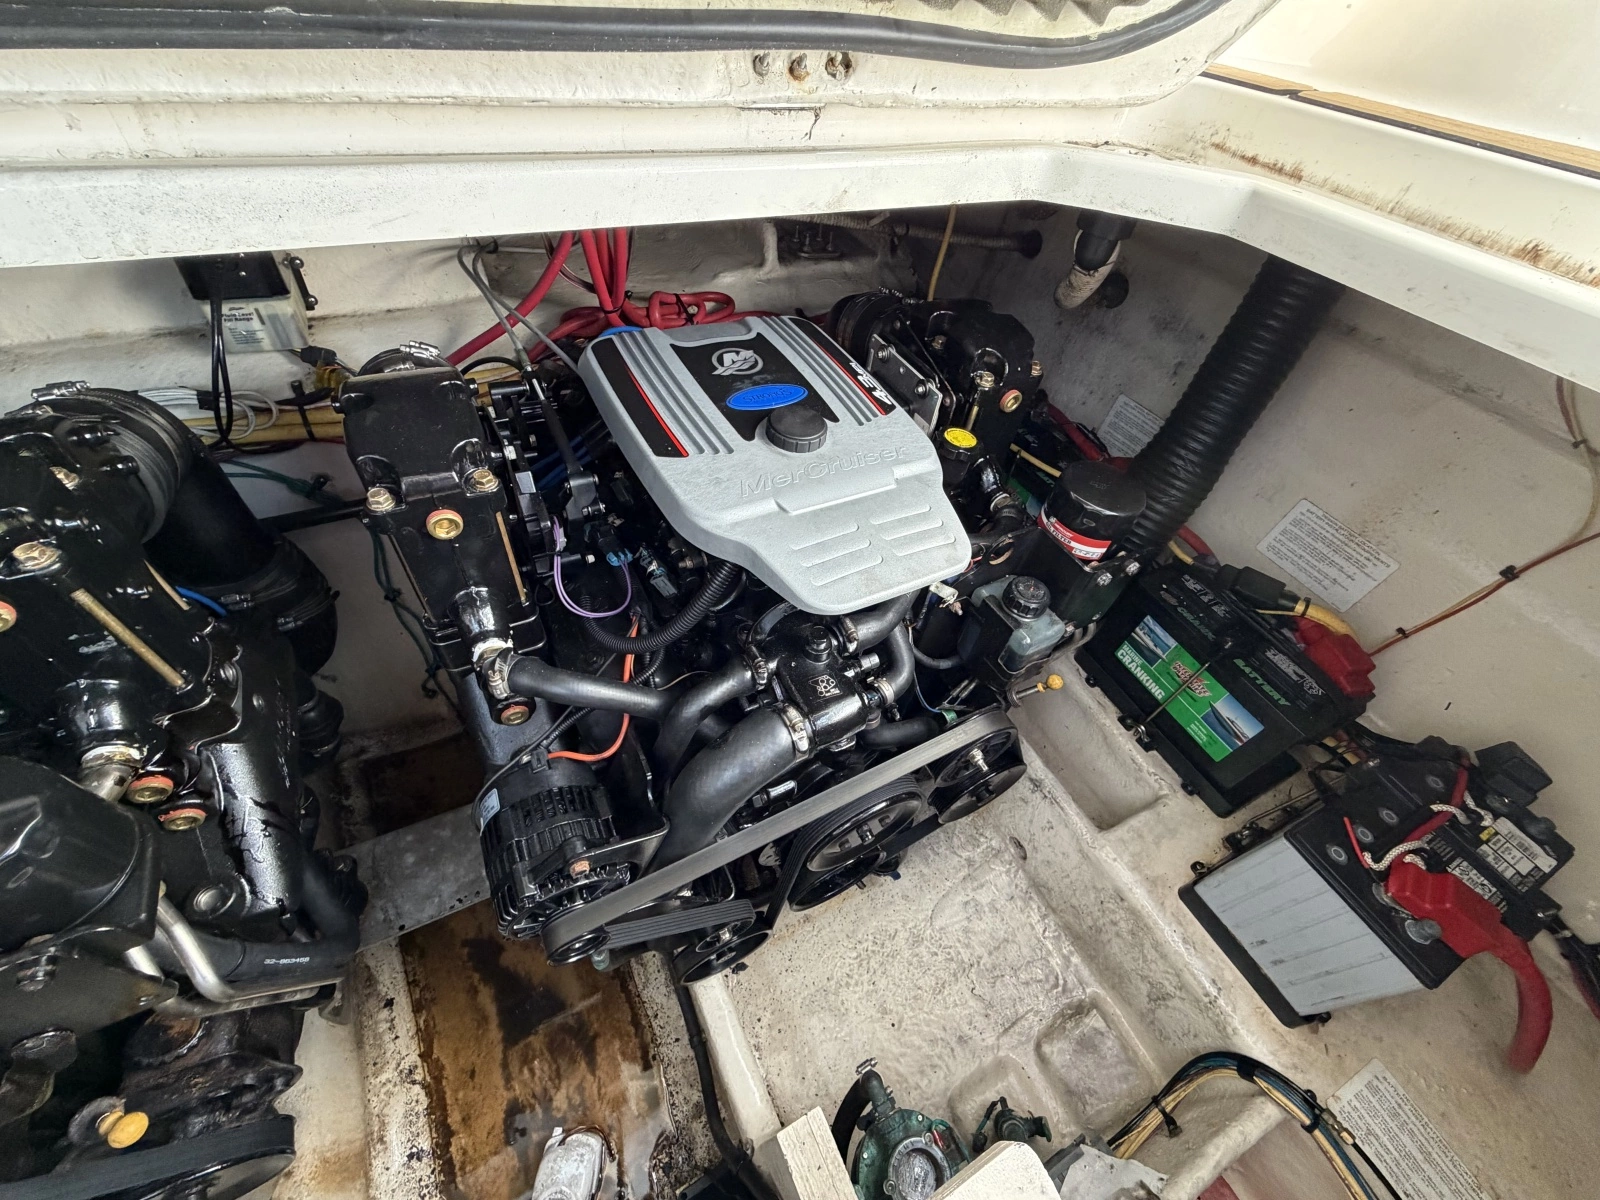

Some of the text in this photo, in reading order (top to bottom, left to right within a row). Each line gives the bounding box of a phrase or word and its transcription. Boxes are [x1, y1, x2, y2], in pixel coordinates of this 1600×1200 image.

[740, 446, 907, 497] MerCruiser
[1115, 644, 1166, 700] MARINE CRANKING
[1232, 655, 1290, 709] BATTERY
